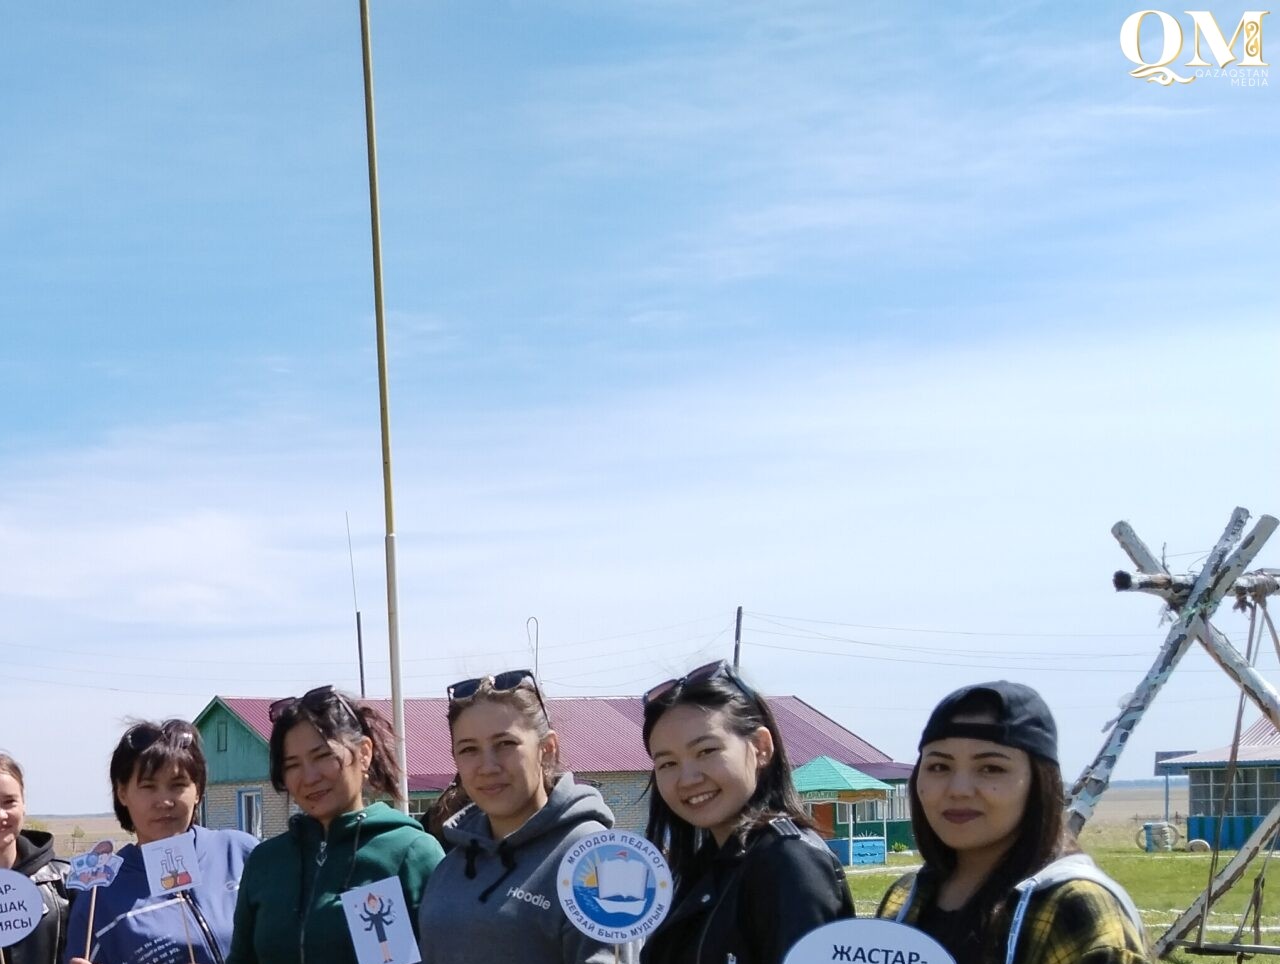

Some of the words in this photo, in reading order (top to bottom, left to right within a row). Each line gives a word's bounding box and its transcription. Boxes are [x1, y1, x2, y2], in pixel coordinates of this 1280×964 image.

[567, 833, 616, 865] МОЛОДОЙ
[620, 835, 665, 869] ПЕДАГОГ
[506, 886, 551, 910] Hoodie
[564, 898, 596, 933] ДЕРЗАЙ
[597, 928, 628, 939] БЫТЬ
[630, 903, 666, 937] МУДРЫМ
